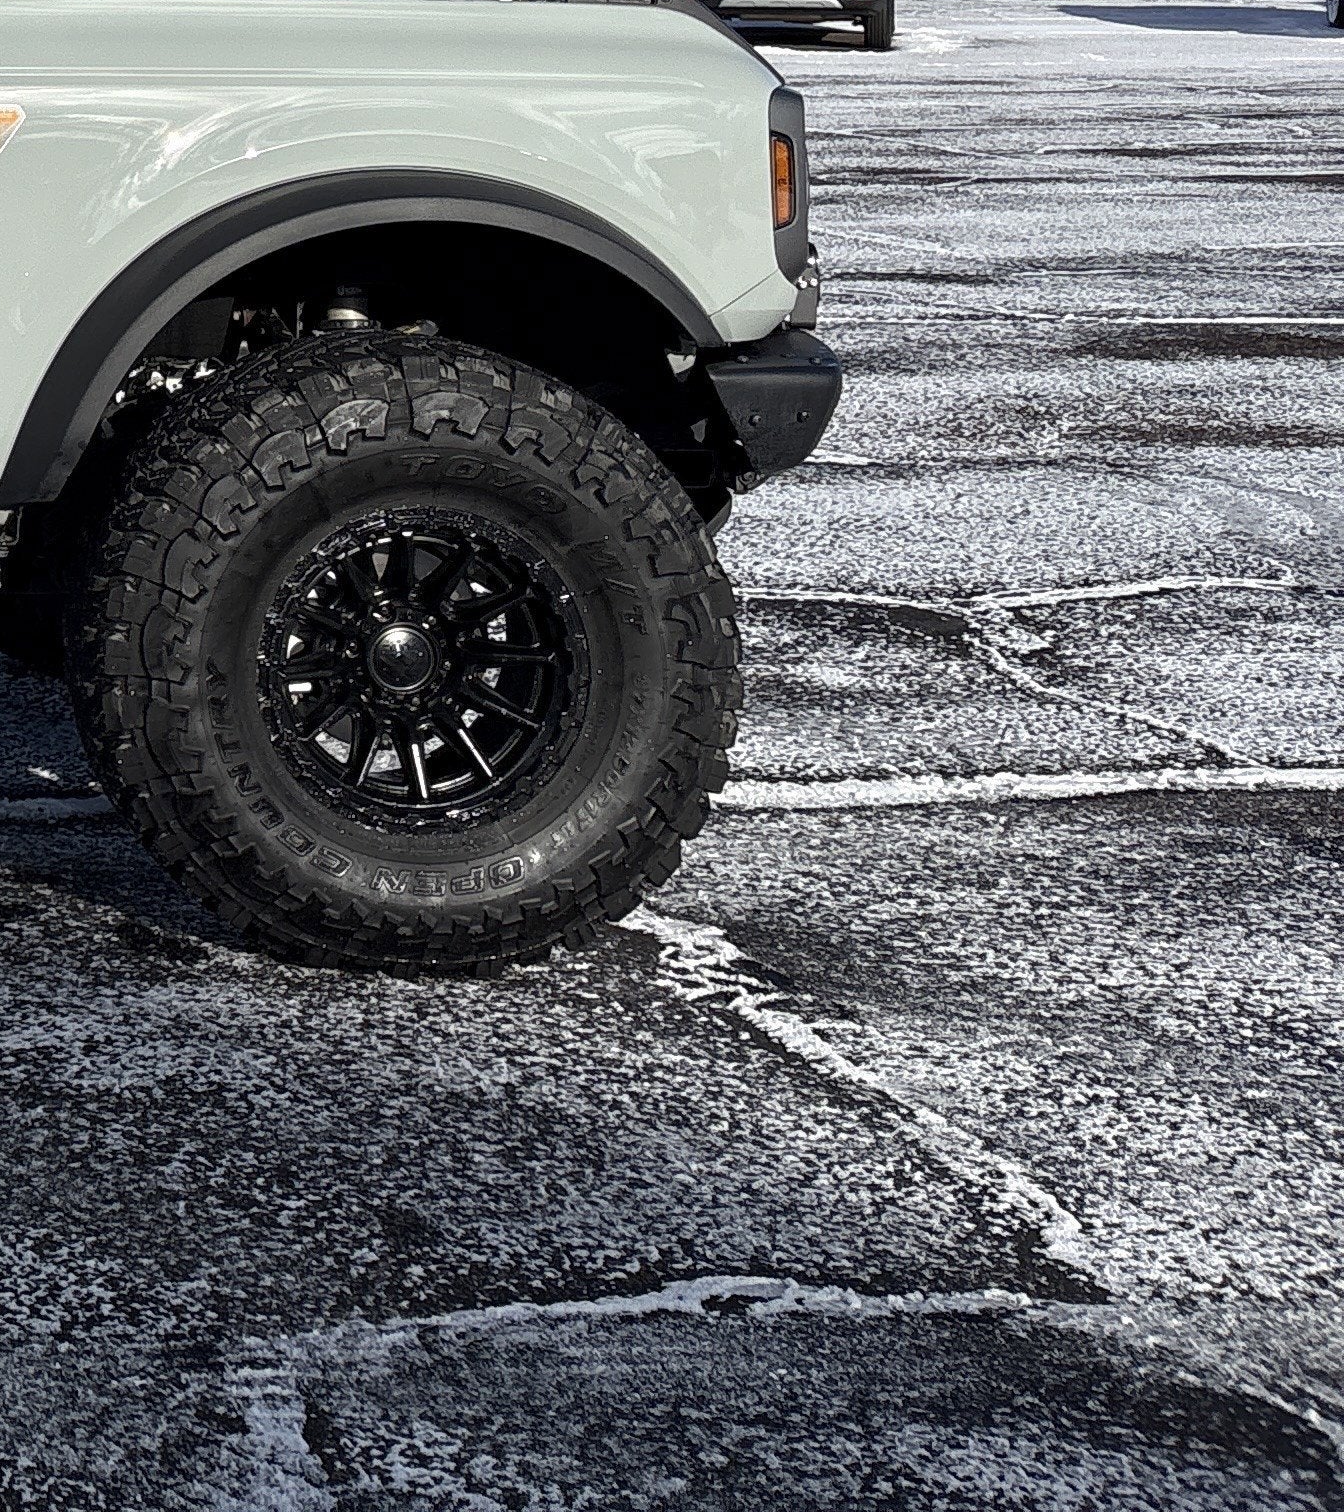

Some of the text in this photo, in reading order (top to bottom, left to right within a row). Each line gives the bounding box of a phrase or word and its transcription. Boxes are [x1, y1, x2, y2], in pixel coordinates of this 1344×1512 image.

[399, 453, 568, 514] TOYO
[206, 656, 526, 897] OPEN COUNTRY
